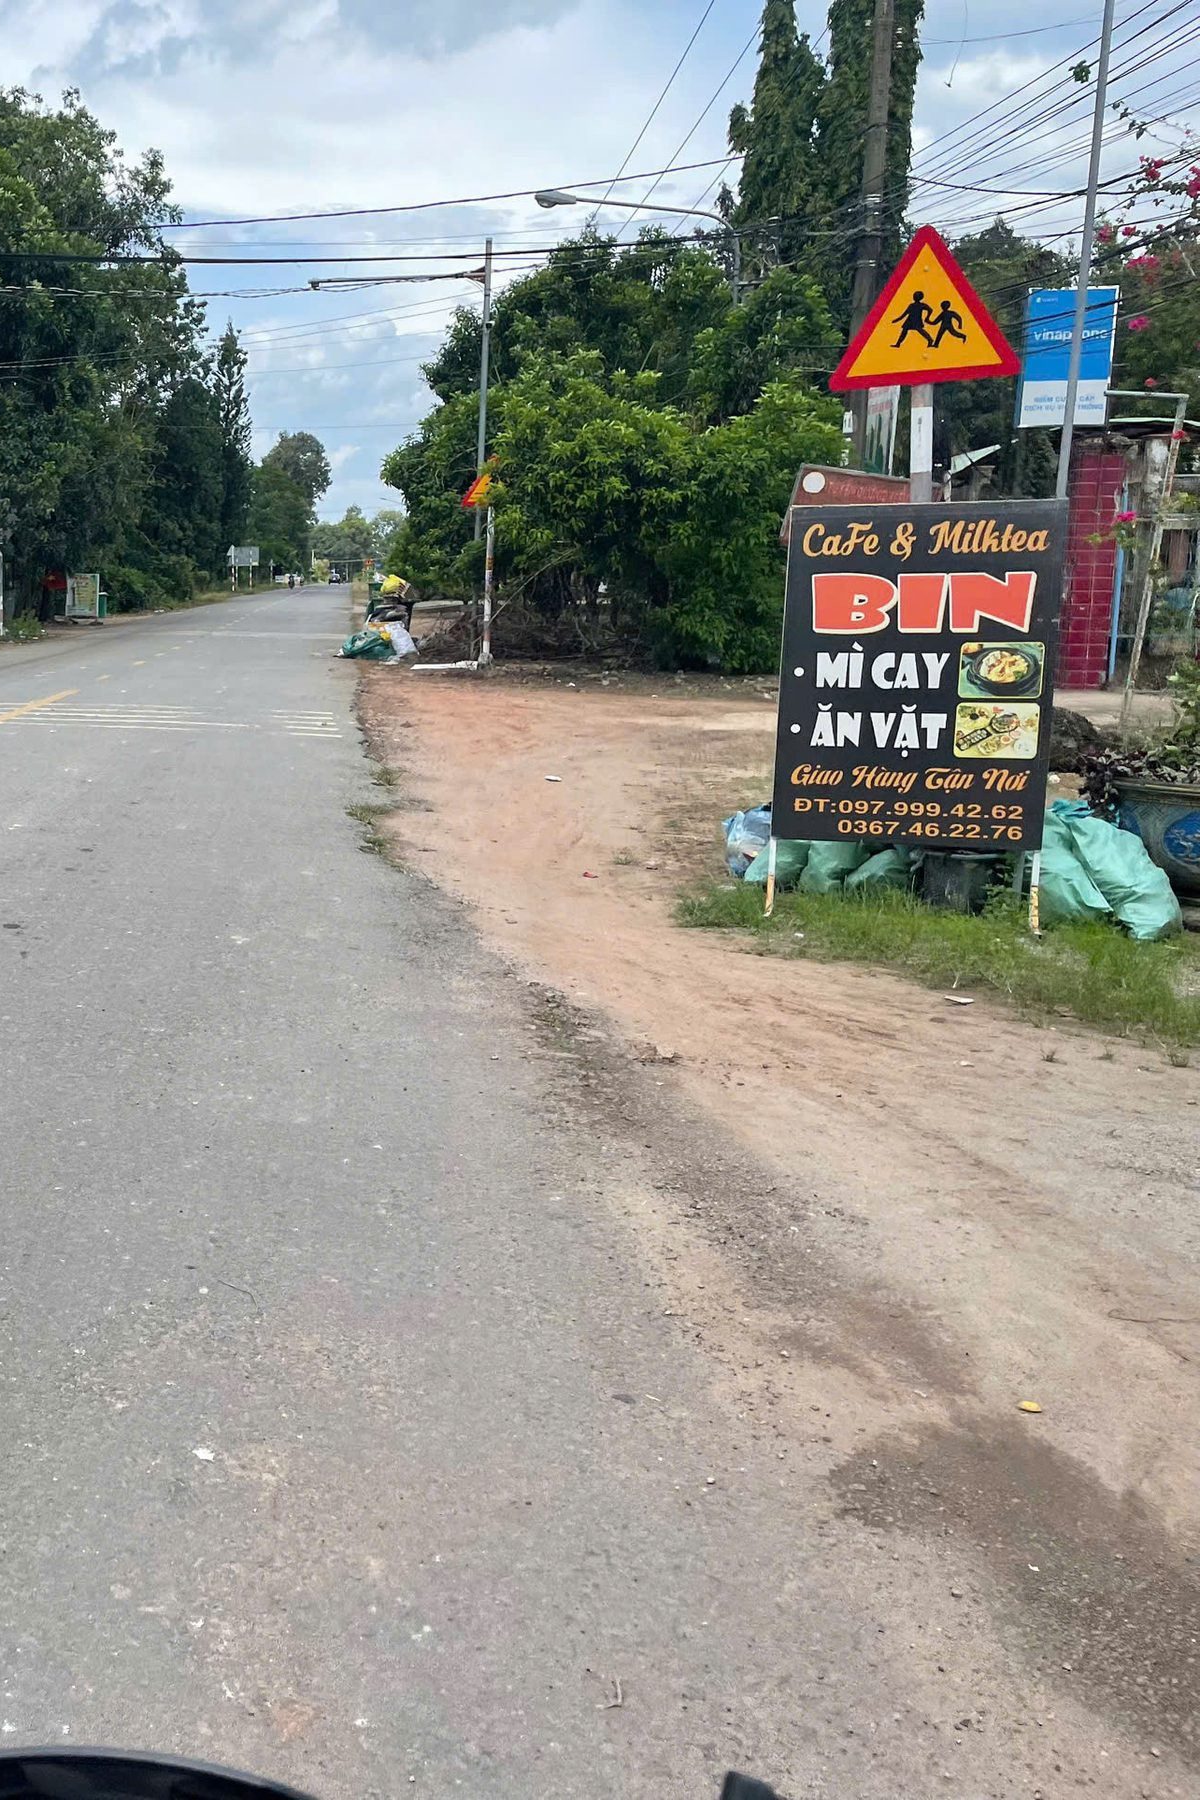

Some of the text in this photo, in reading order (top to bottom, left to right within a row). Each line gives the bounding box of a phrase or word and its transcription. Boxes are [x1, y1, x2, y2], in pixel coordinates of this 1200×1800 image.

[1034, 328, 1109, 342] vinapone
[802, 519, 1050, 562] CaFe & Milktea
[811, 571, 1038, 635] BIN
[816, 641, 951, 689] MÌ CAY
[809, 702, 948, 758] ĂN VẶT
[790, 763, 1031, 794] Giao Hàng Tận Nơi
[793, 798, 1024, 820] ĐT:097.999.42.62
[837, 819, 1024, 841] 0367.46.22.76
